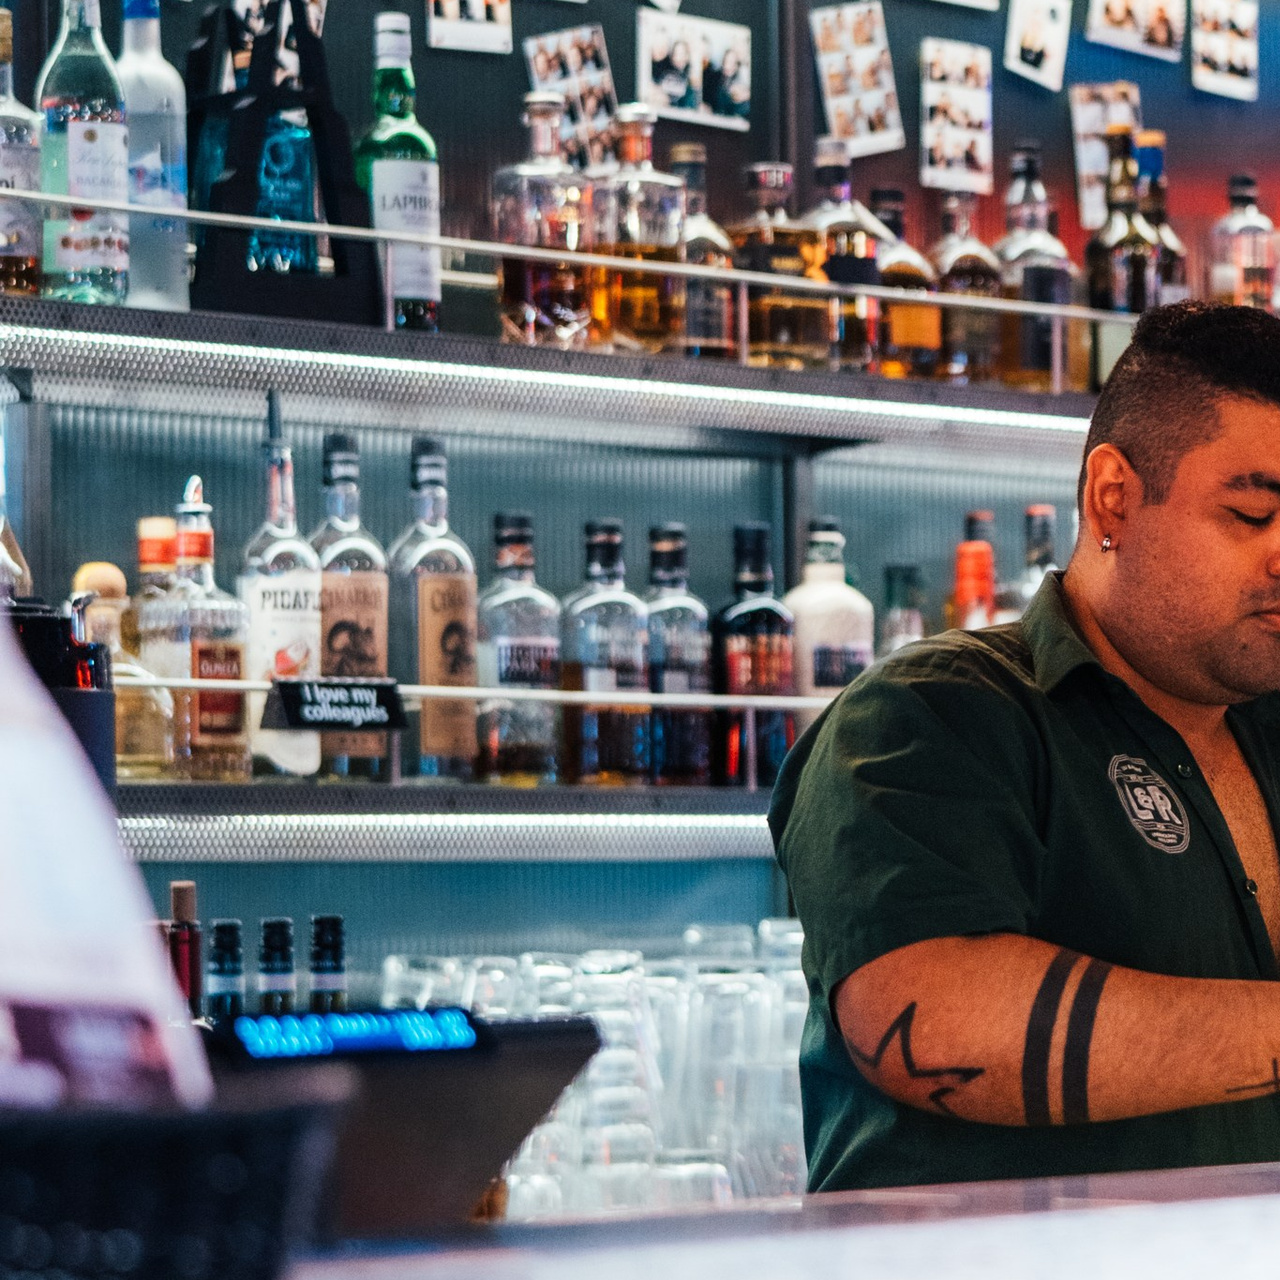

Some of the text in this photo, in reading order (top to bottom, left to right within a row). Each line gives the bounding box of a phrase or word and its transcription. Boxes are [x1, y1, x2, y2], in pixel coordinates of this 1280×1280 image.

[303, 683, 377, 709] I love my
[303, 702, 389, 727] colleagues
